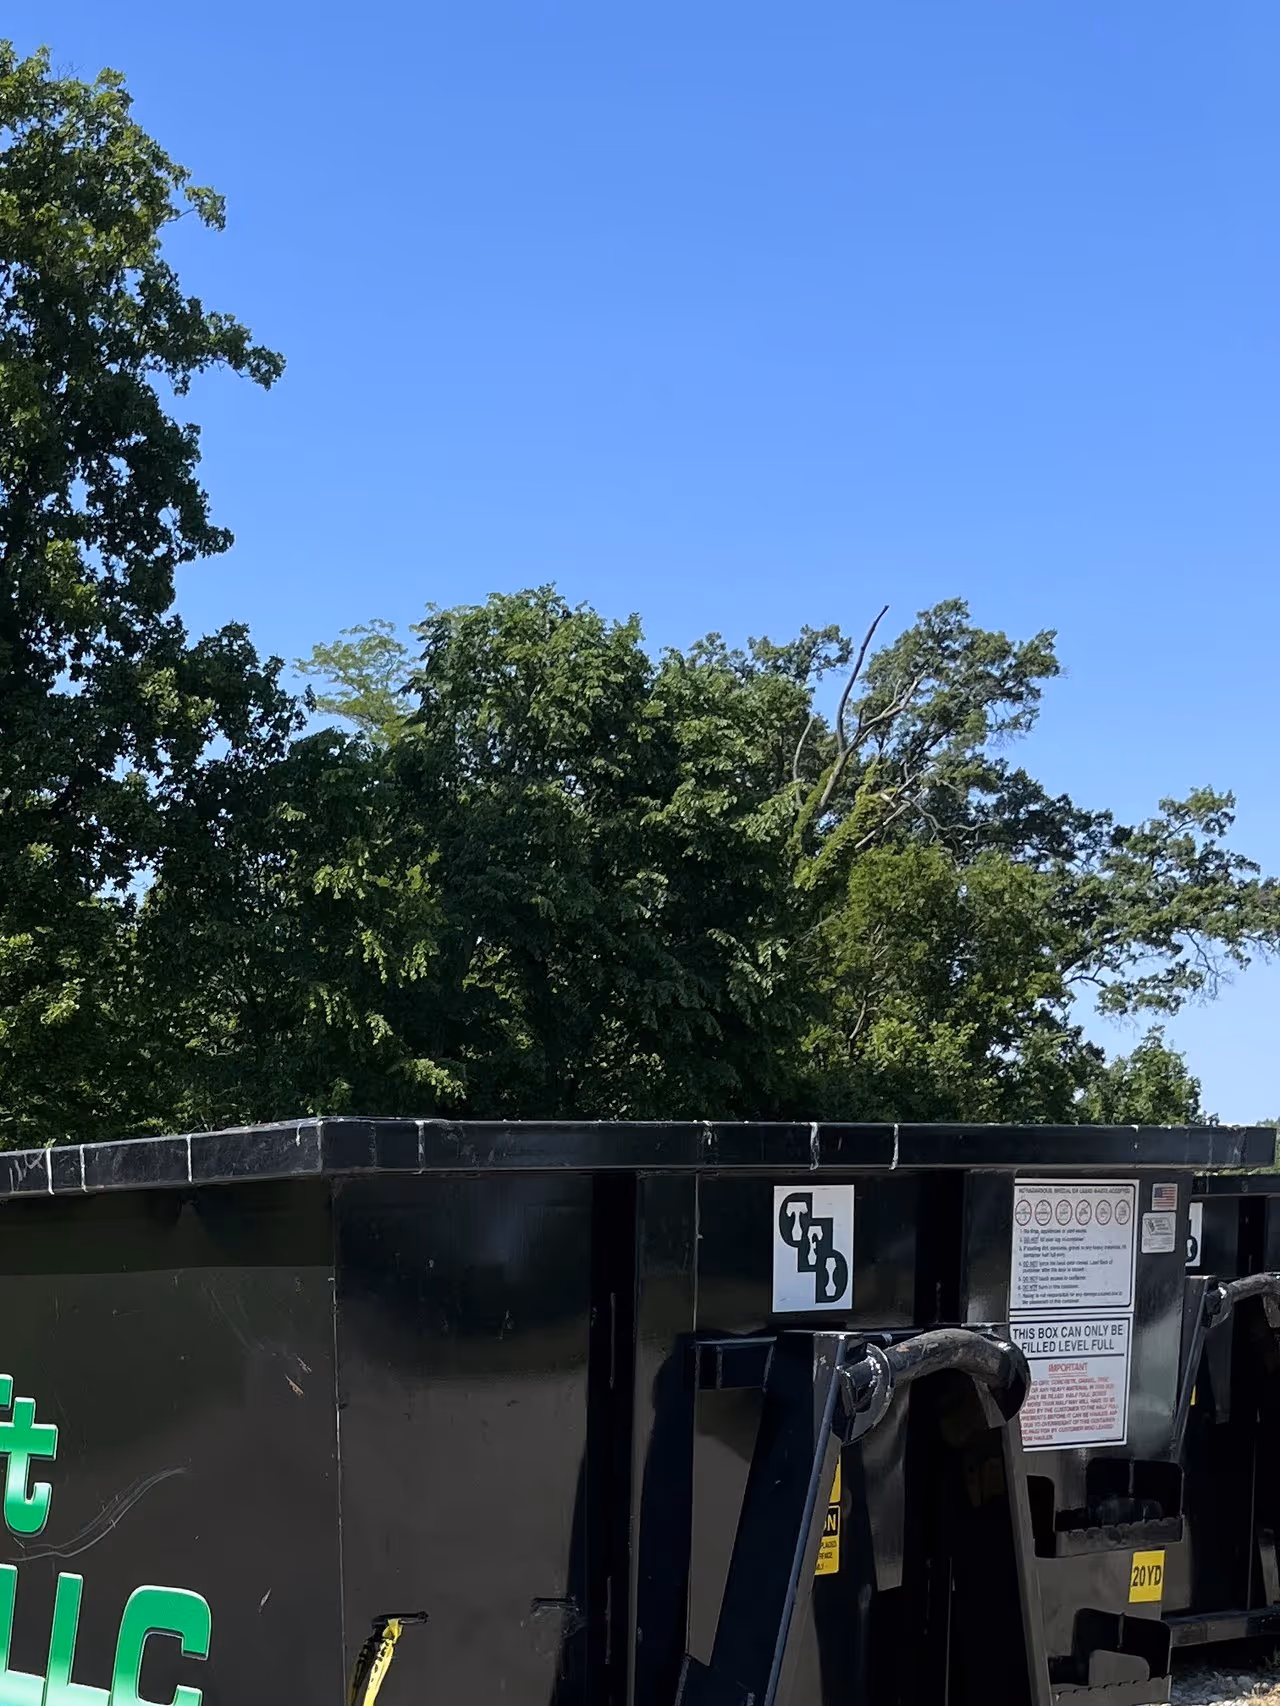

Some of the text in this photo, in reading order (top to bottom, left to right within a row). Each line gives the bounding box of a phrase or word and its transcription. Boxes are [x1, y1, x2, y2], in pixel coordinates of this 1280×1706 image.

[1013, 1324, 1123, 1340] THIS BOX CAN ONLY BE
[1021, 1338, 1114, 1353] FILLED LEVEL FULL
[1048, 1362, 1088, 1373] IMPORTANT
